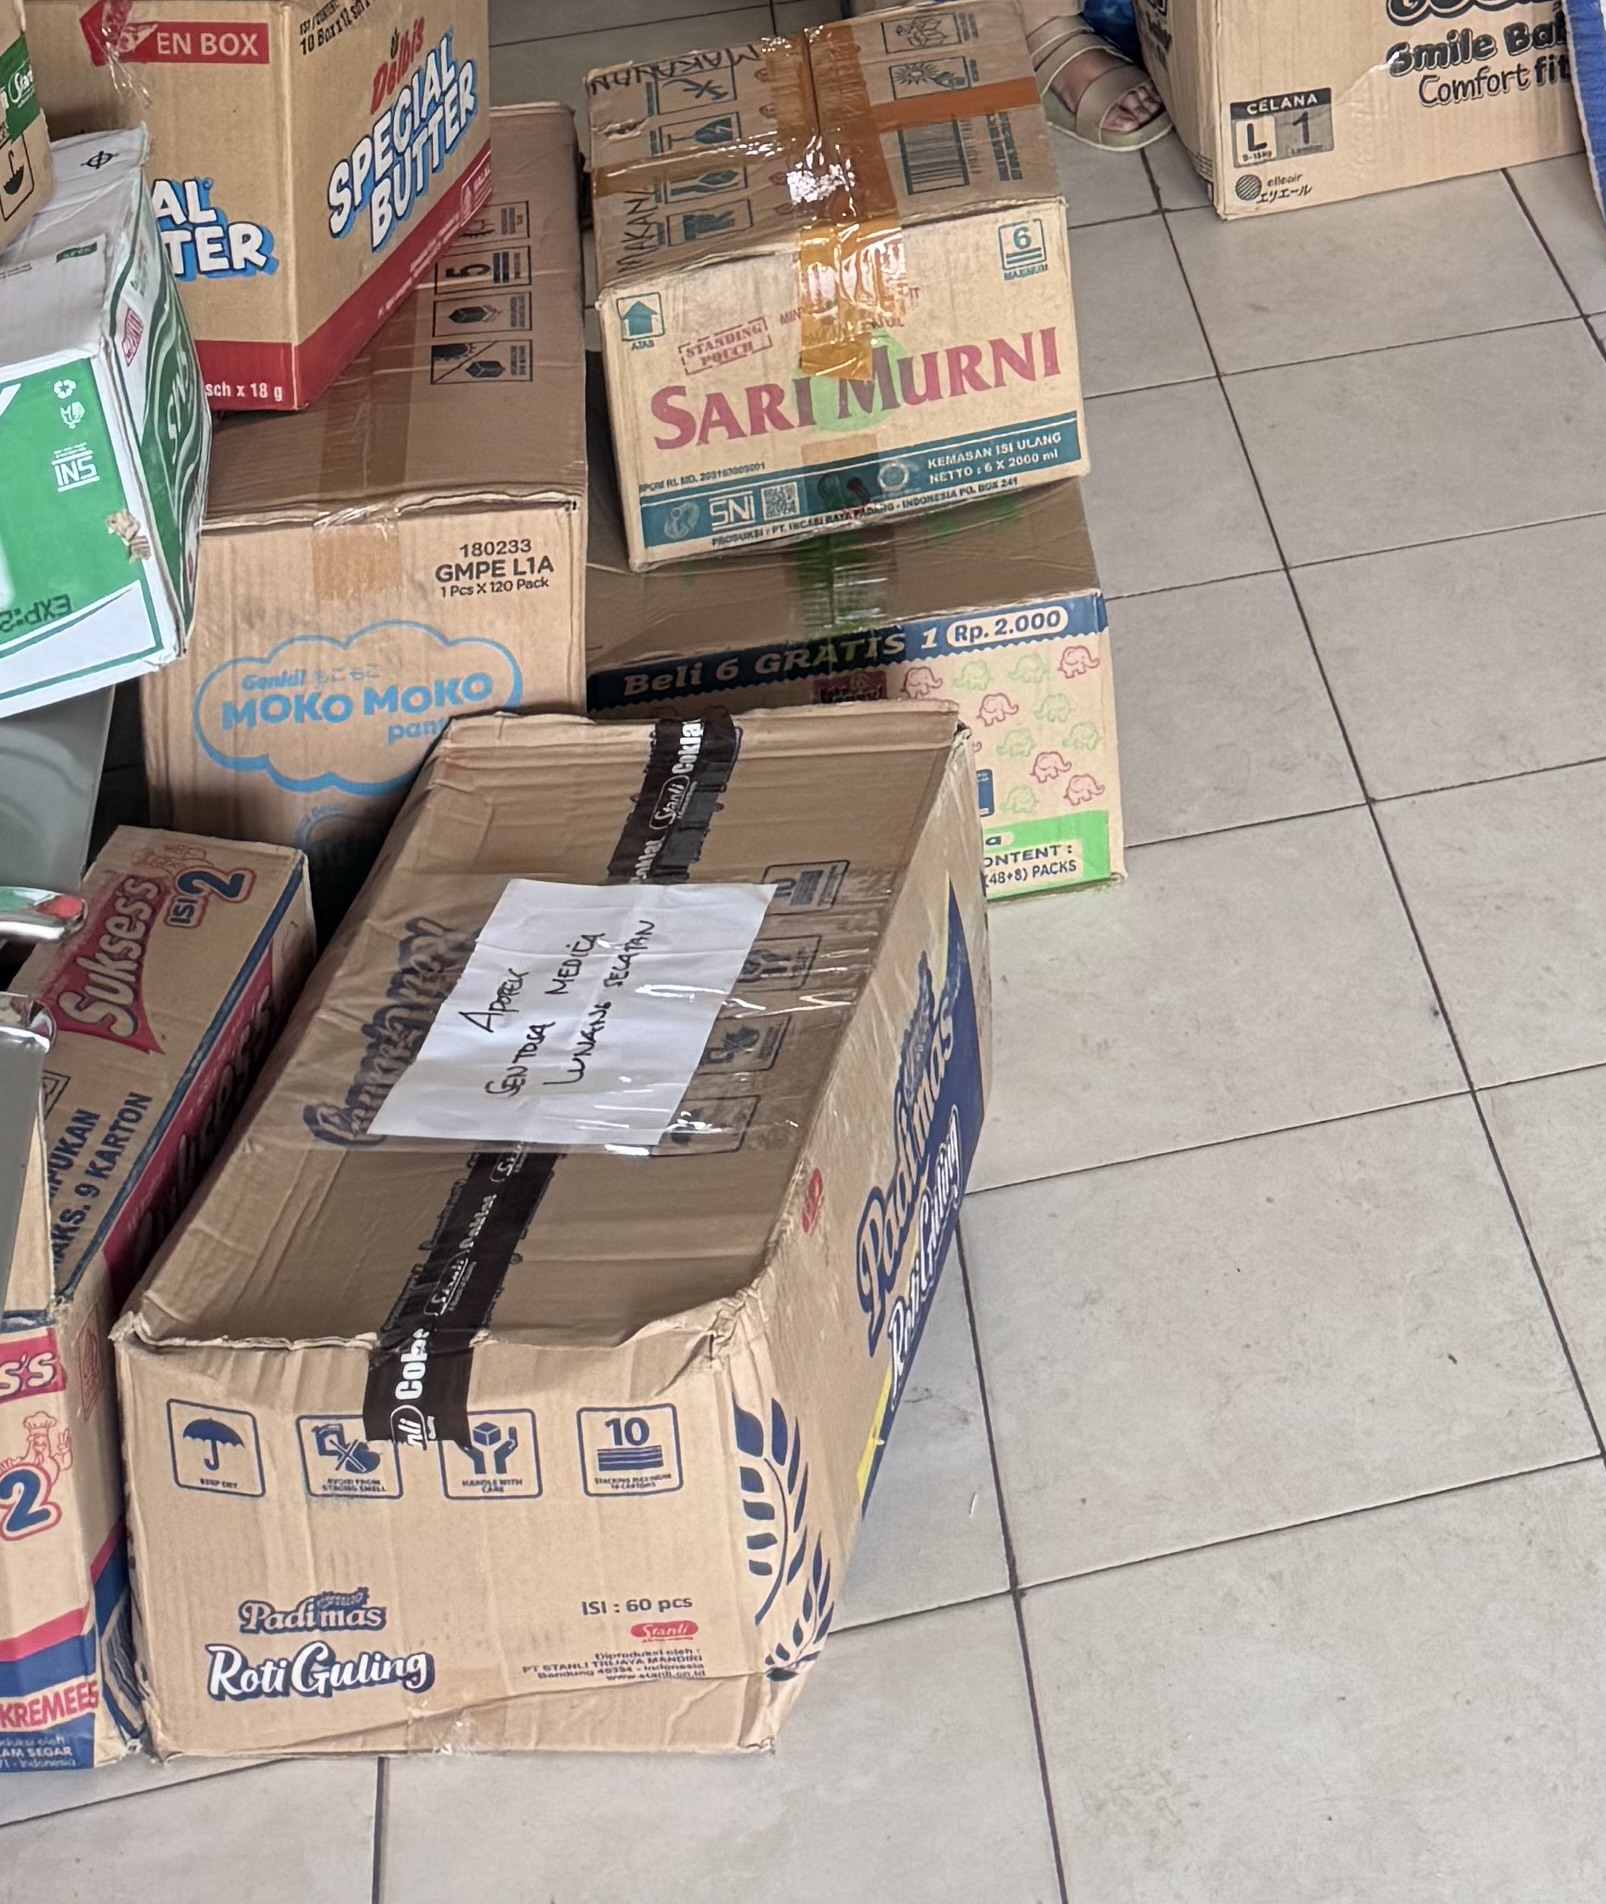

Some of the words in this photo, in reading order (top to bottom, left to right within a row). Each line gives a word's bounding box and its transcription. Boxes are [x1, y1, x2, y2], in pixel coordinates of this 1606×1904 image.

[200, 33, 259, 57] BOX
[299, 35, 317, 57] 10
[1387, 28, 1497, 76] Smile
[1420, 61, 1530, 107] Comfort
[1247, 93, 1318, 115] CELANA
[328, 36, 457, 237] SPECIAL
[1247, 123, 1267, 152] L
[1292, 111, 1312, 146] 1
[371, 59, 476, 252] BUTTER
[1012, 227, 1033, 249] 6
[445, 263, 492, 279] 5
[685, 322, 763, 359] STANDING
[700, 342, 755, 367] POUCH
[205, 382, 232, 399] sch
[251, 383, 268, 399] 18
[273, 386, 284, 402] g
[650, 376, 817, 450] SARI
[838, 326, 1061, 420] MURNI
[927, 447, 992, 470] KEMASAN
[995, 442, 1014, 456] ISI
[1016, 431, 1062, 451] ULANG
[928, 465, 974, 486] NETTO
[1007, 452, 1040, 470] 2000
[1041, 448, 1060, 463] ml
[710, 494, 754, 527] SNI
[459, 538, 532, 559] 180233
[435, 559, 506, 583] GMPE
[512, 555, 554, 577] L1A
[449, 582, 474, 597] Pcs
[489, 580, 513, 593] 120
[516, 576, 550, 591] Pack
[624, 661, 702, 696] Beli
[716, 657, 739, 680] 6
[755, 632, 906, 675] GRATIS
[920, 629, 938, 649] 1
[953, 620, 989, 644] Rp.
[994, 608, 1062, 635] 2.000
[221, 691, 354, 731] MOKO
[362, 671, 494, 718] MOKO
[175, 867, 248, 902] 2
[1033, 859, 1077, 880] PACKS
[168, 896, 198, 925] ISI
[89, 1091, 154, 1182] KARTON
[84, 1182, 101, 1200] 9
[603, 1416, 651, 1449] 10
[1, 1468, 53, 1532] 2
[242, 1595, 384, 1632] Padimas
[581, 1601, 607, 1616] ISI
[626, 1598, 652, 1612] 60
[658, 1597, 693, 1613] pcs
[207, 1644, 288, 1698] Roti
[291, 1641, 429, 1695] Guling
